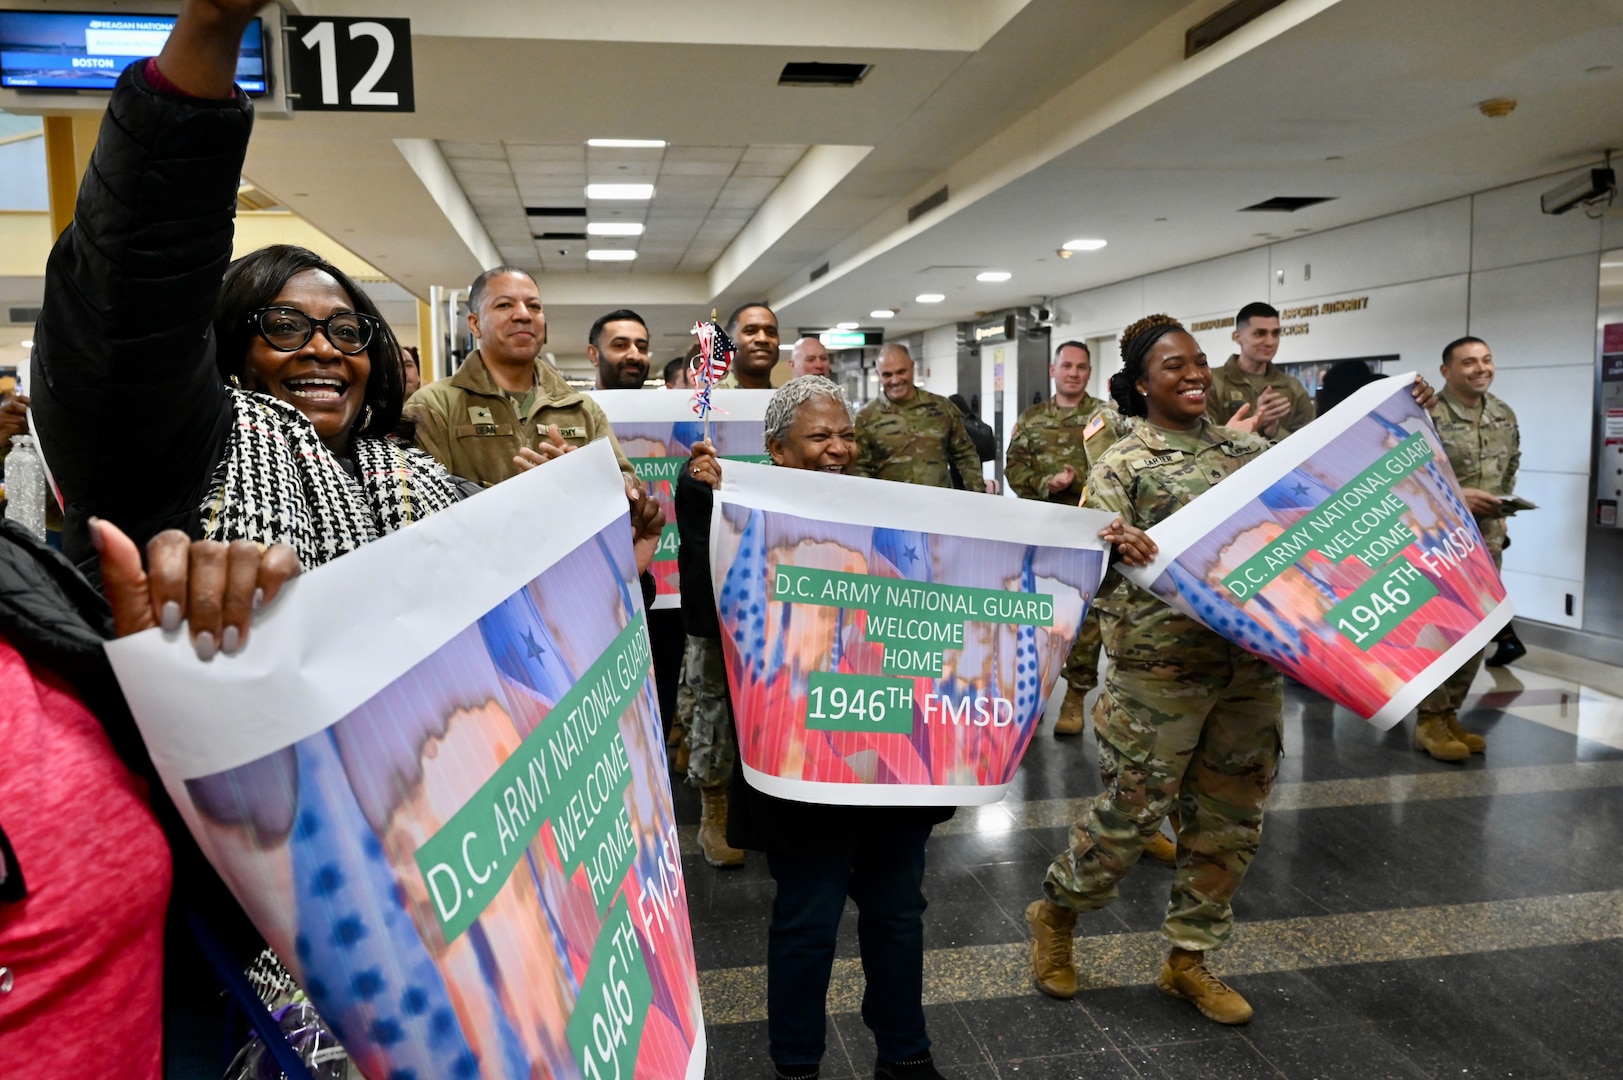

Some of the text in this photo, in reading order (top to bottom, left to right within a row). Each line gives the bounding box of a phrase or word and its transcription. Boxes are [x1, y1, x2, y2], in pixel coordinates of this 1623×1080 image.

[101, 21, 175, 30] REAGAN NATIONA
[72, 58, 114, 68] BOSTON
[302, 21, 398, 105] 12
[1282, 304, 1319, 320] AIRPORTS
[1321, 296, 1368, 314] AUTHORITY
[635, 462, 677, 477] ARMY
[1228, 437, 1432, 599] D.C. ARMY NATIONAL GUARD
[1318, 489, 1405, 561] WELCOME
[1357, 522, 1413, 568] HOME
[775, 573, 1053, 621] D.C. ARMY NATIONAL GUARD
[1338, 526, 1475, 644] 1946TH FMSD
[867, 614, 963, 643] WELCOME
[883, 648, 942, 672] HOME
[809, 686, 1014, 728] 1946TH FMSD
[427, 624, 650, 922] D.C. ARMY NATIONAL GUARD
[552, 732, 629, 863] WELCOME
[586, 806, 635, 906] HOME
